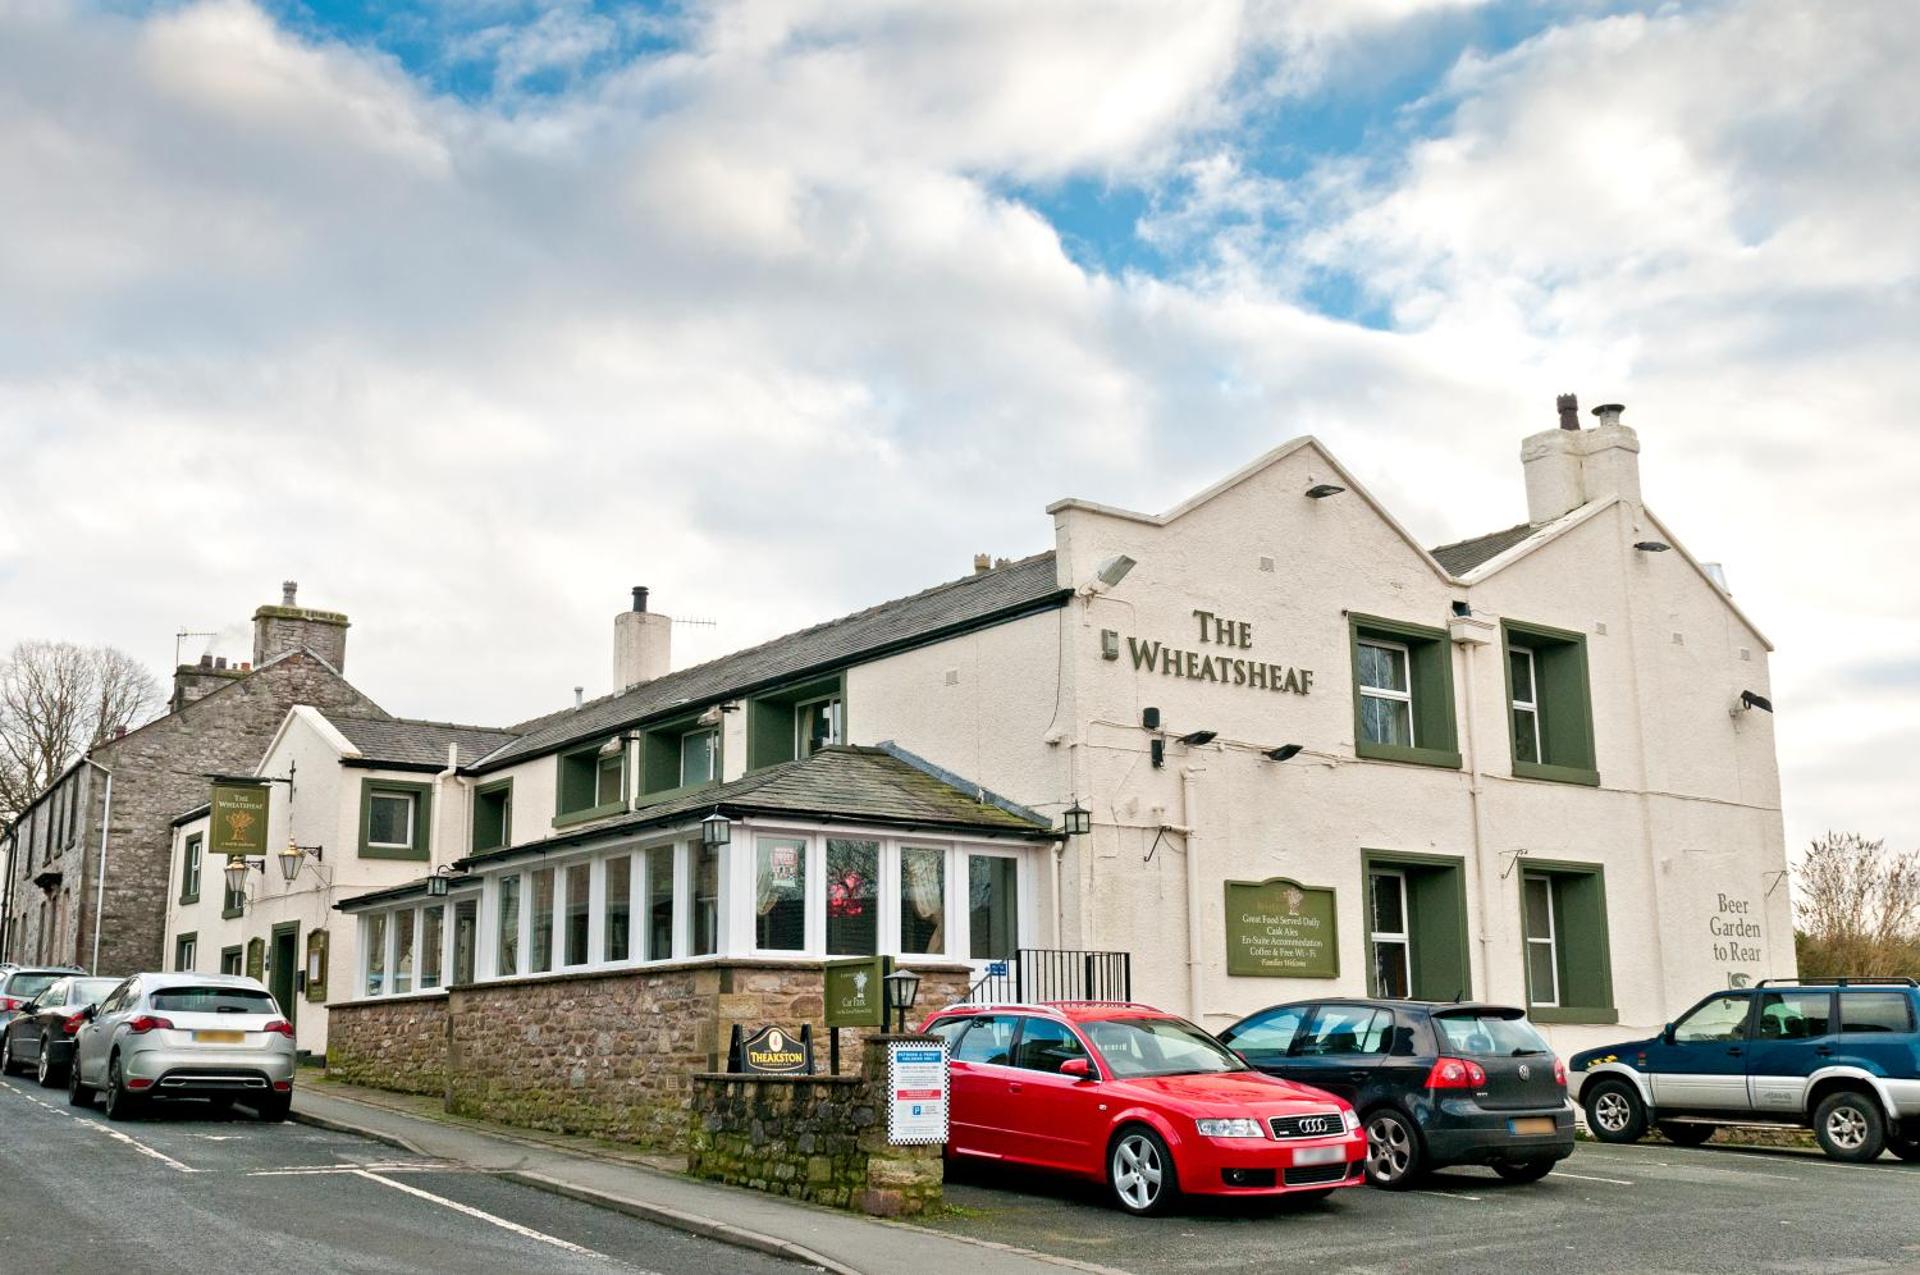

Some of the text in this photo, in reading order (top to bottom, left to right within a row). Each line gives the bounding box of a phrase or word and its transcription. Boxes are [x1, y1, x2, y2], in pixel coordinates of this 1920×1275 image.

[1193, 609, 1253, 649] THE
[1126, 636, 1314, 696] WHEATSHEAF
[1717, 892, 1749, 914] Beer
[1709, 915, 1760, 938] Garden
[1713, 941, 1761, 961] to Rear
[750, 1051, 802, 1063] THEAKSTON
